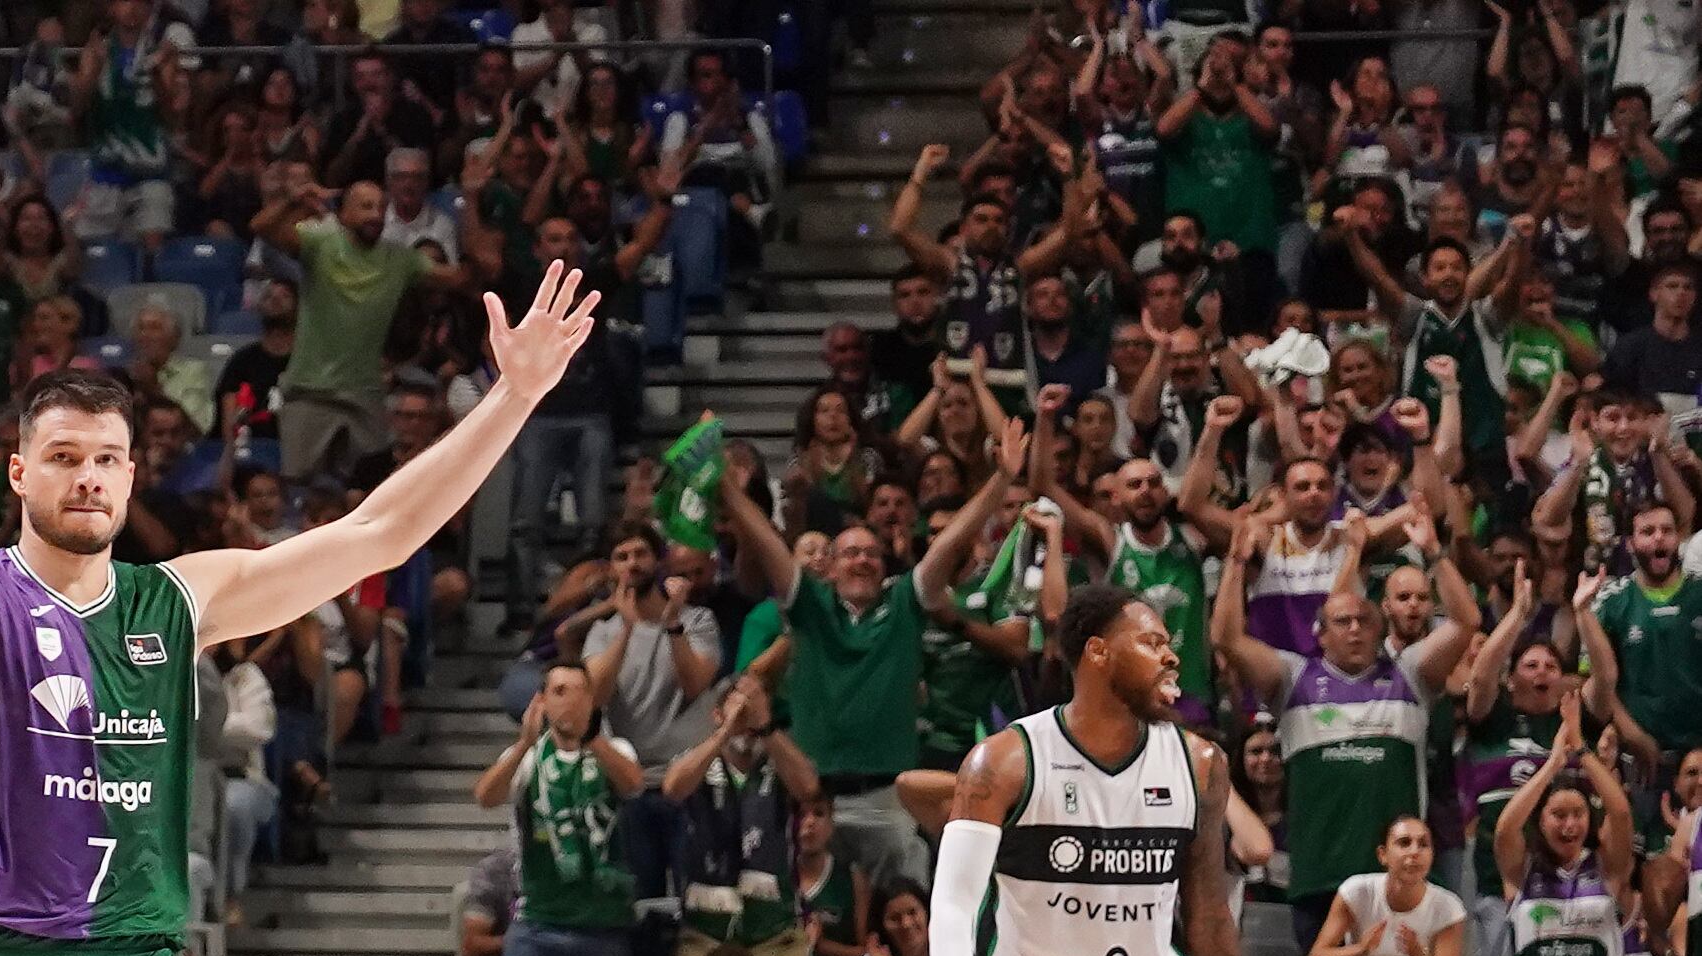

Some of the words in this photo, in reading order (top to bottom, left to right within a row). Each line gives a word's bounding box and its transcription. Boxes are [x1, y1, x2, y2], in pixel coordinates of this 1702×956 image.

[90, 709, 166, 739] Unicaja
[86, 836, 117, 903] 7
[1047, 892, 1162, 921] JOVENT
